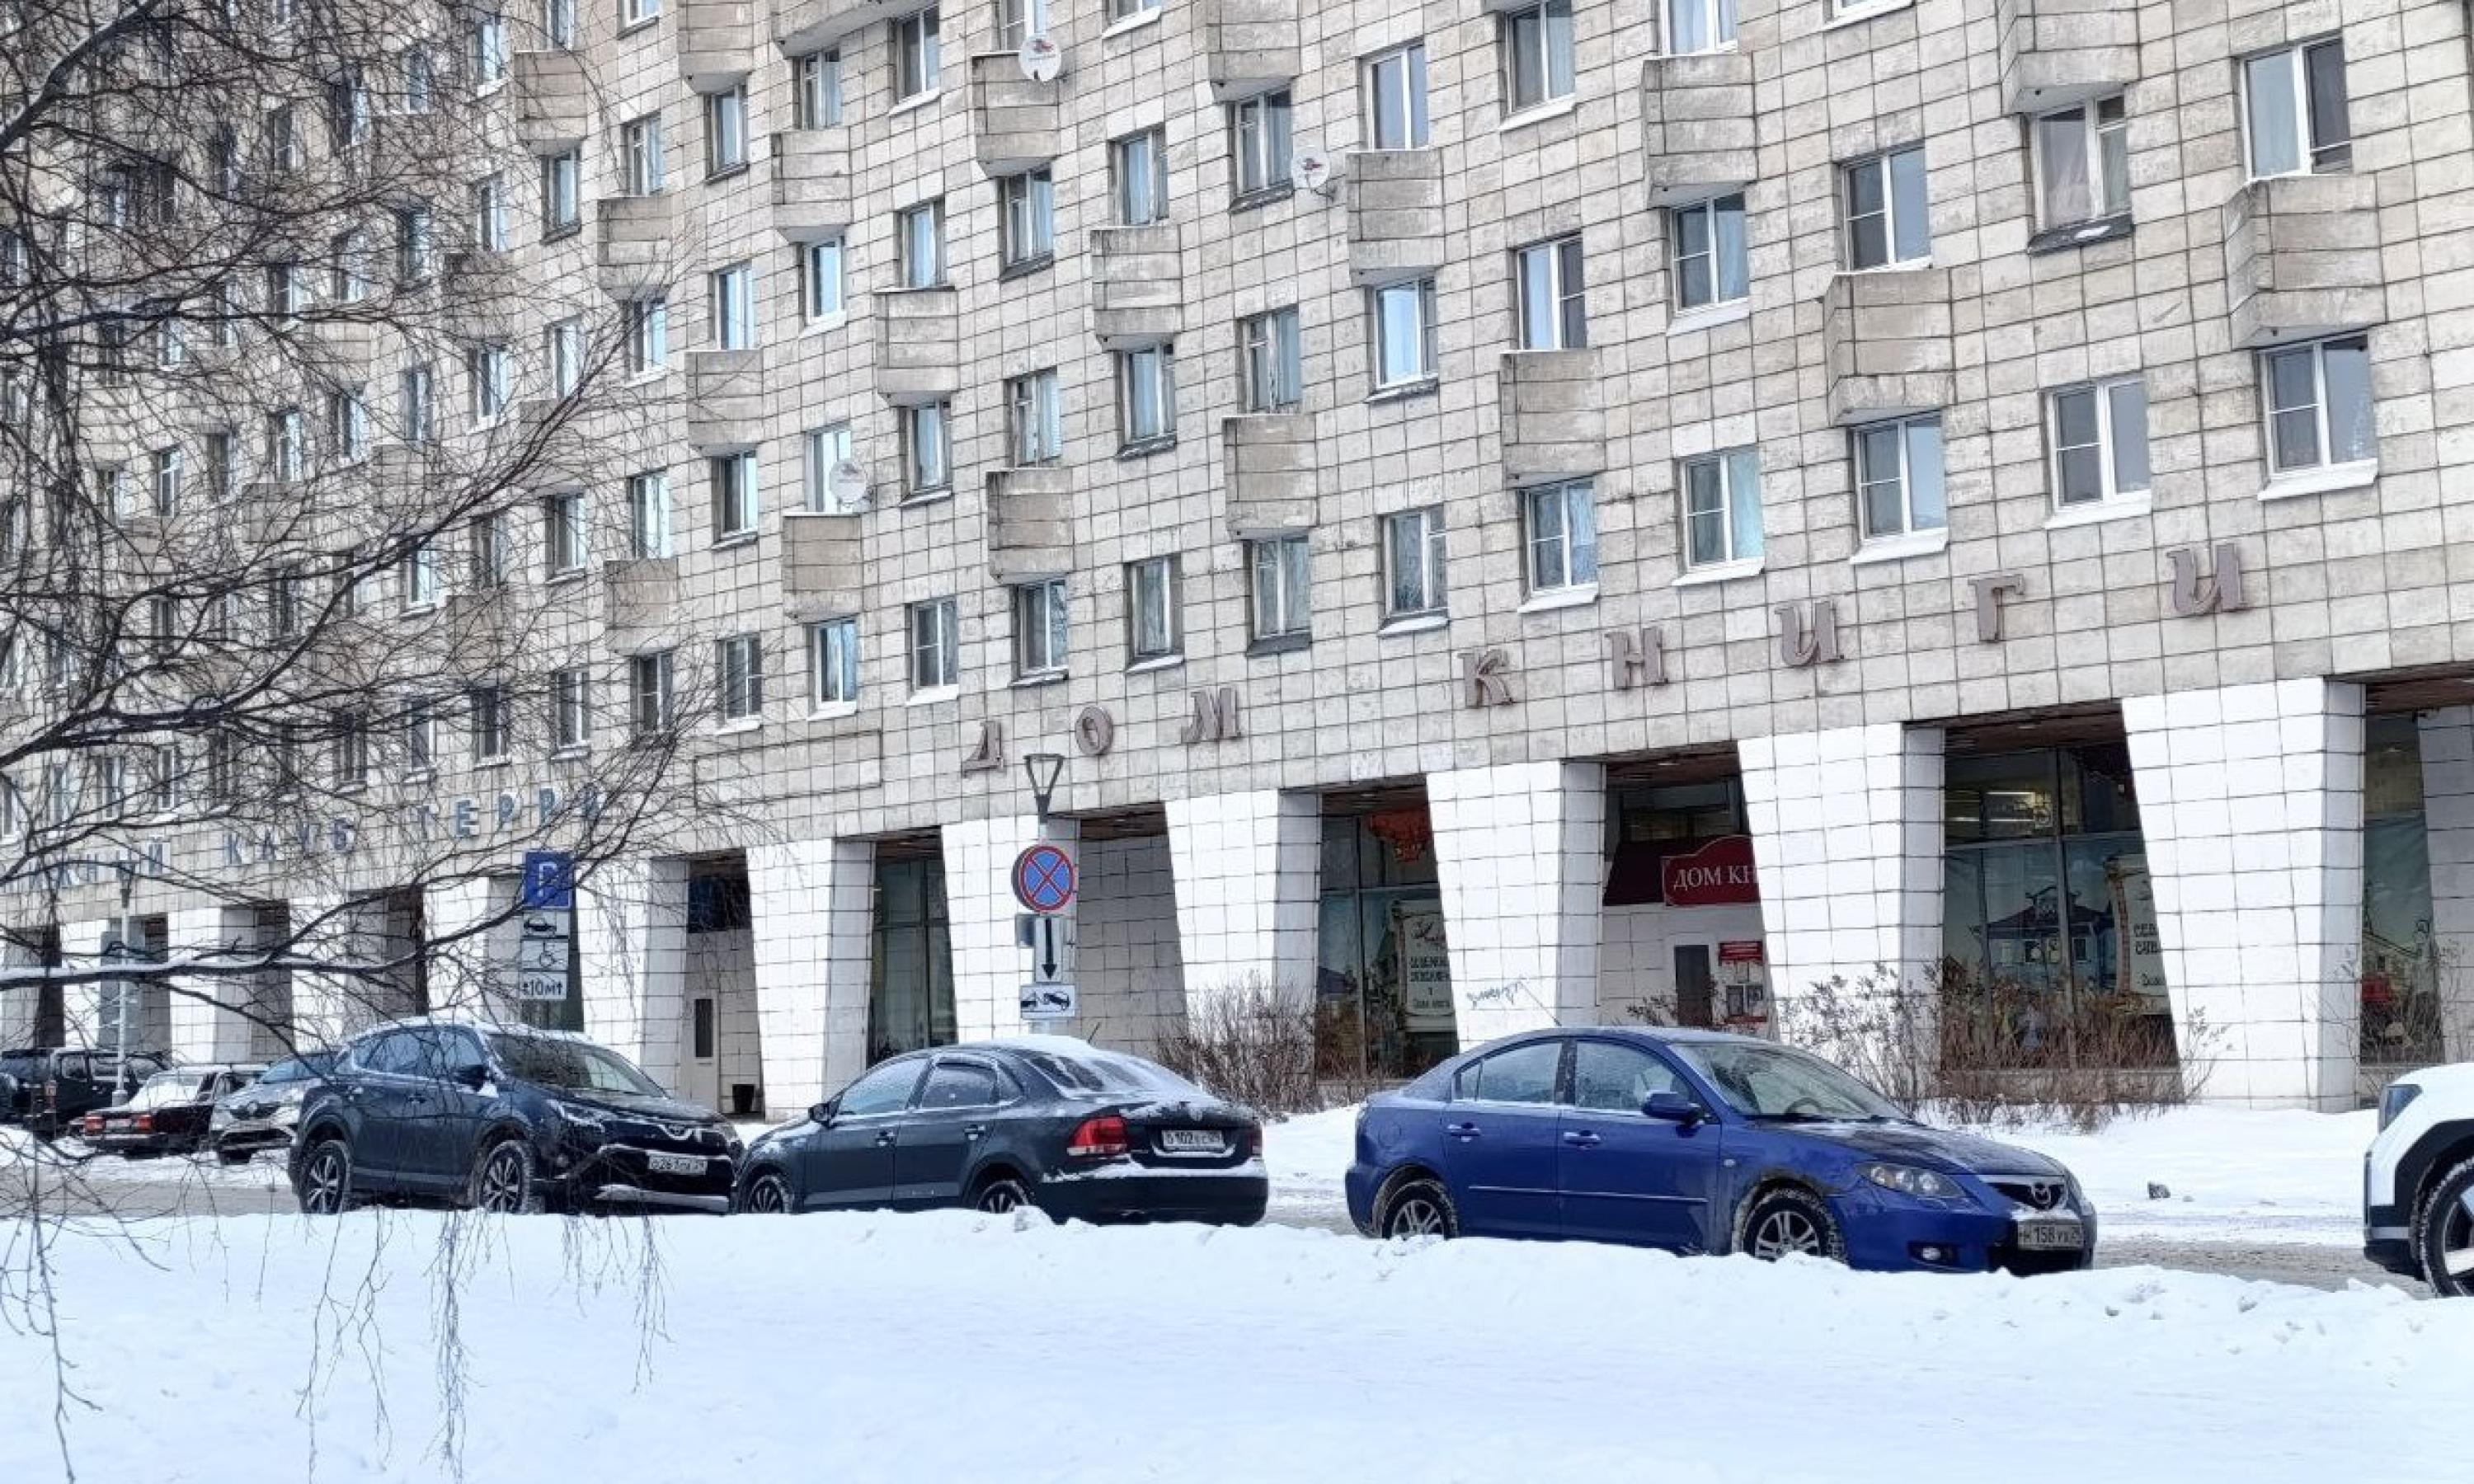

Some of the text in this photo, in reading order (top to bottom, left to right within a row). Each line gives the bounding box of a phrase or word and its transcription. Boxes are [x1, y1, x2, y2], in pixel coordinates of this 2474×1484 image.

[961, 542, 2250, 778] ДОМ КНИГИ
[1673, 866, 1722, 891] ДОМ
